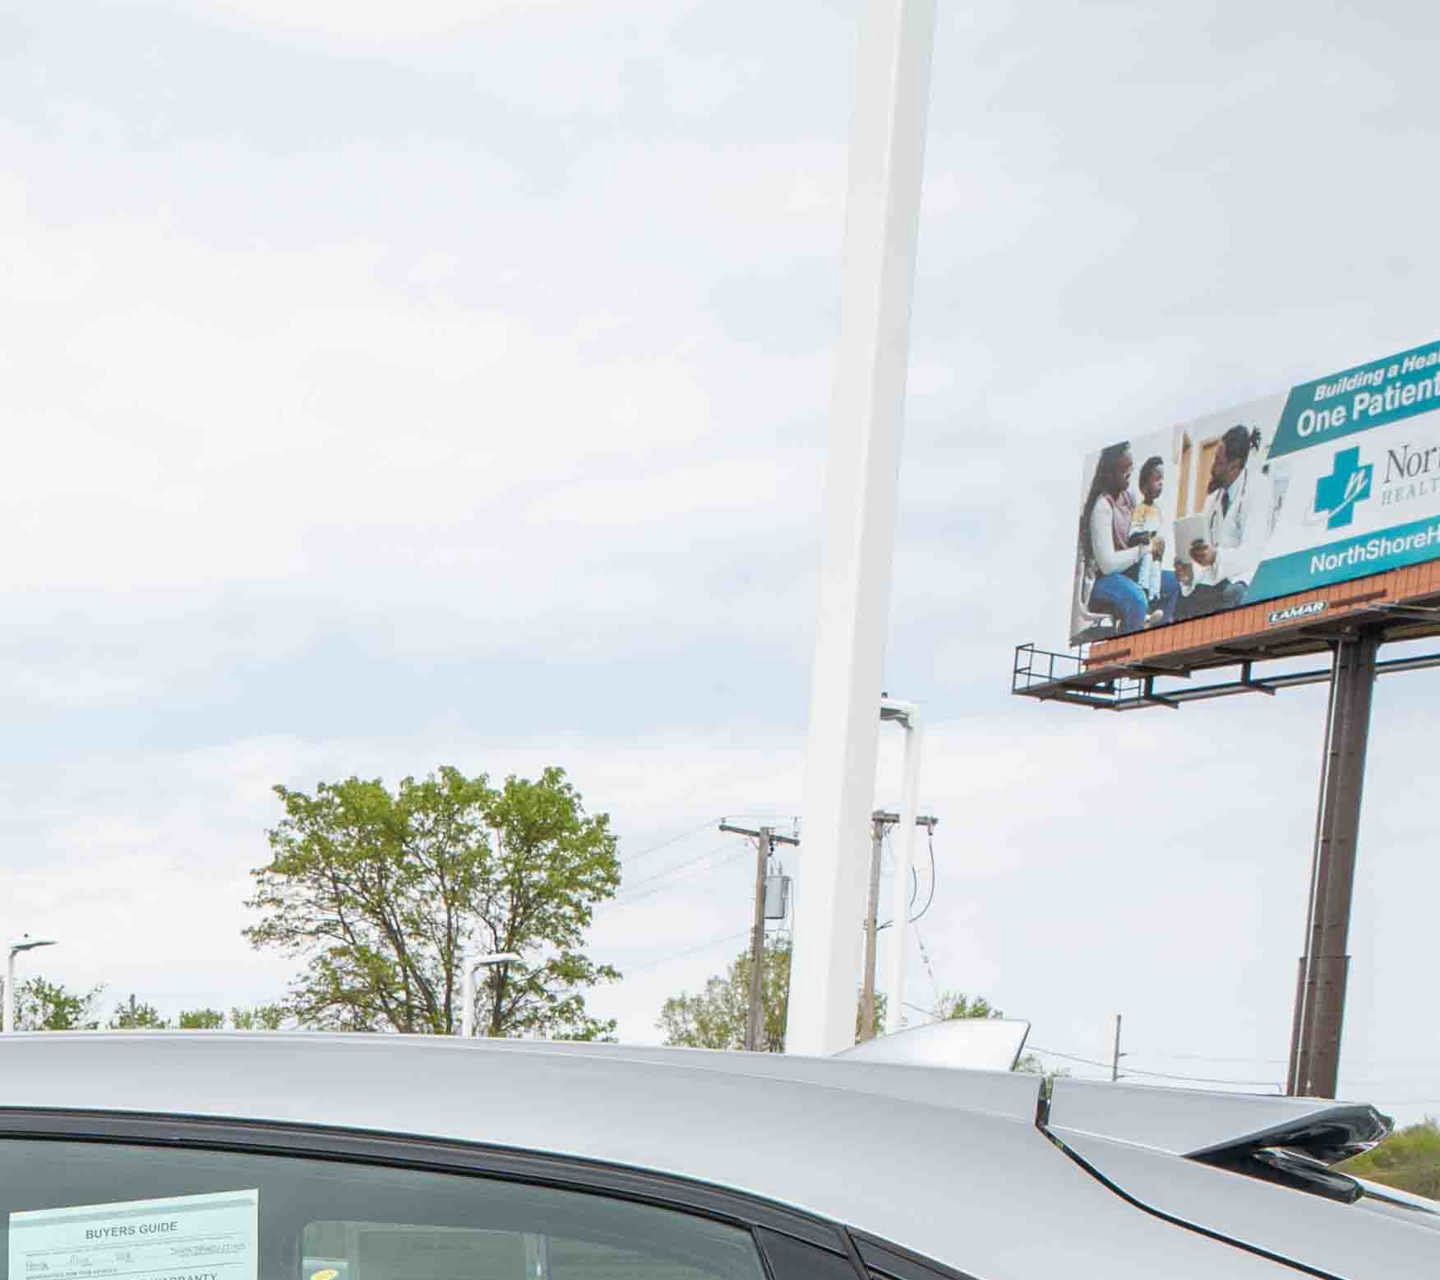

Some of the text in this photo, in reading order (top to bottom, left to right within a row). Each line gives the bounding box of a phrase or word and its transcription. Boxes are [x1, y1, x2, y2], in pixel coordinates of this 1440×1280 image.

[1314, 366, 1385, 402] Building
[1387, 365, 1398, 378] a
[1296, 404, 1347, 437] One
[1271, 602, 1324, 622] LAMAR
[85, 1221, 180, 1240] BUYERS GUIDE
